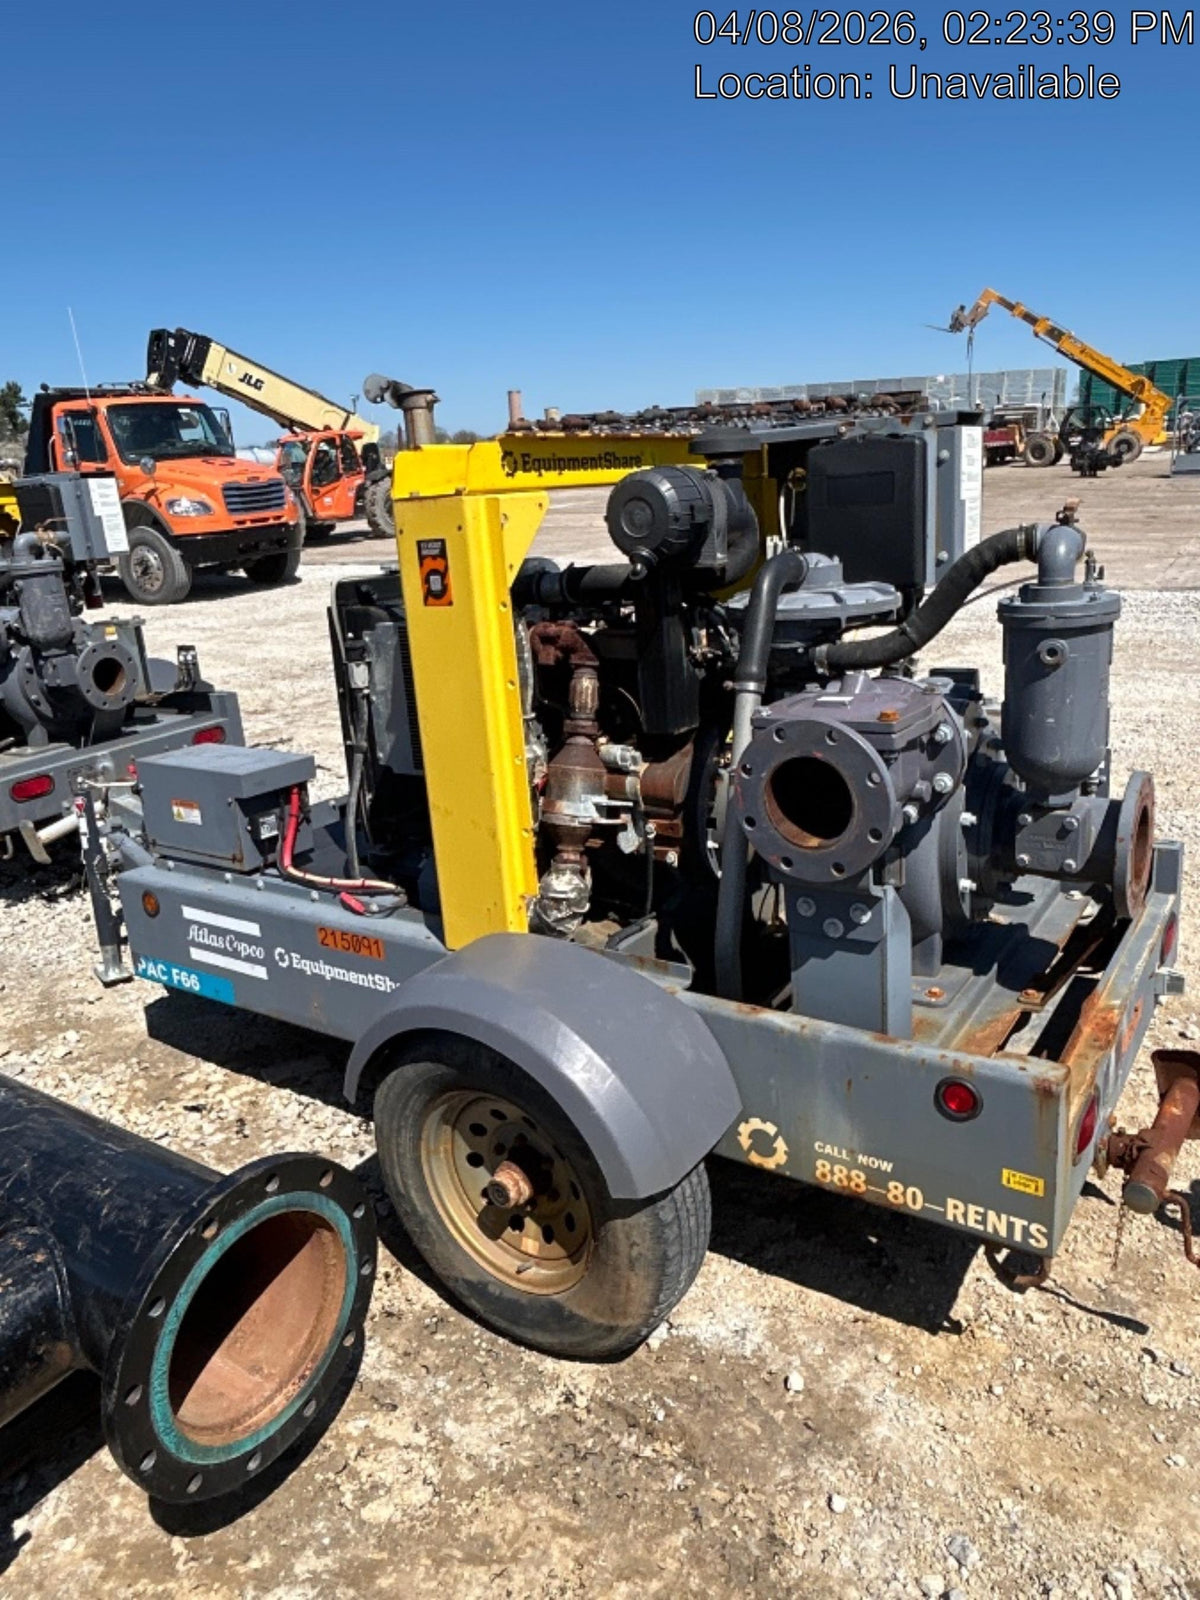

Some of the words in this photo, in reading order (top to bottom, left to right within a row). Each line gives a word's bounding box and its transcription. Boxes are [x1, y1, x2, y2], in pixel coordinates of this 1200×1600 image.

[238, 372, 265, 391] JLG
[520, 452, 643, 477] EquipmentShare
[186, 923, 225, 949] Atlas
[224, 934, 265, 960] Copco
[318, 927, 383, 959] 215091
[171, 967, 200, 992] F66
[814, 1141, 850, 1161] CALL
[857, 1153, 894, 1173] NOW
